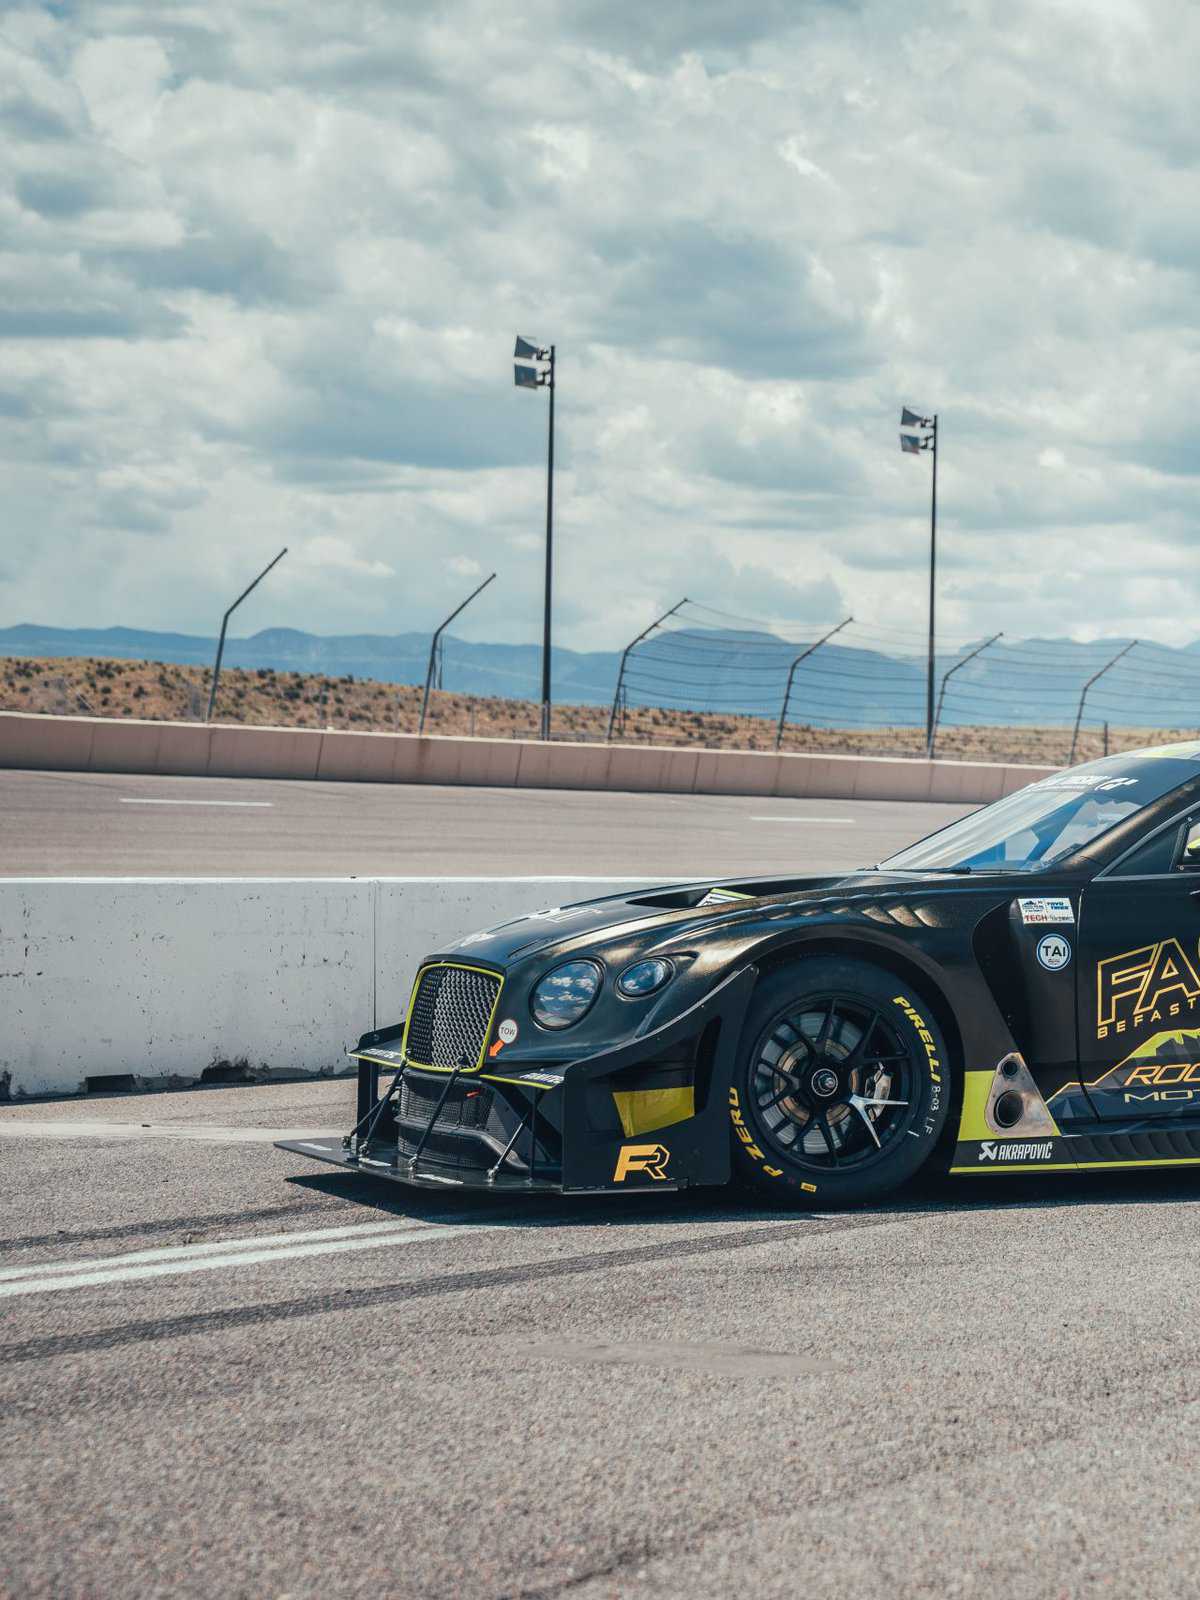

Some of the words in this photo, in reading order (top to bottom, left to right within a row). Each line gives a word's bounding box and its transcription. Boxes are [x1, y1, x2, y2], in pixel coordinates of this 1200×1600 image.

[1042, 945, 1066, 957] TAI
[500, 1026, 516, 1036] TOW
[892, 995, 942, 1083] PIRELLI
